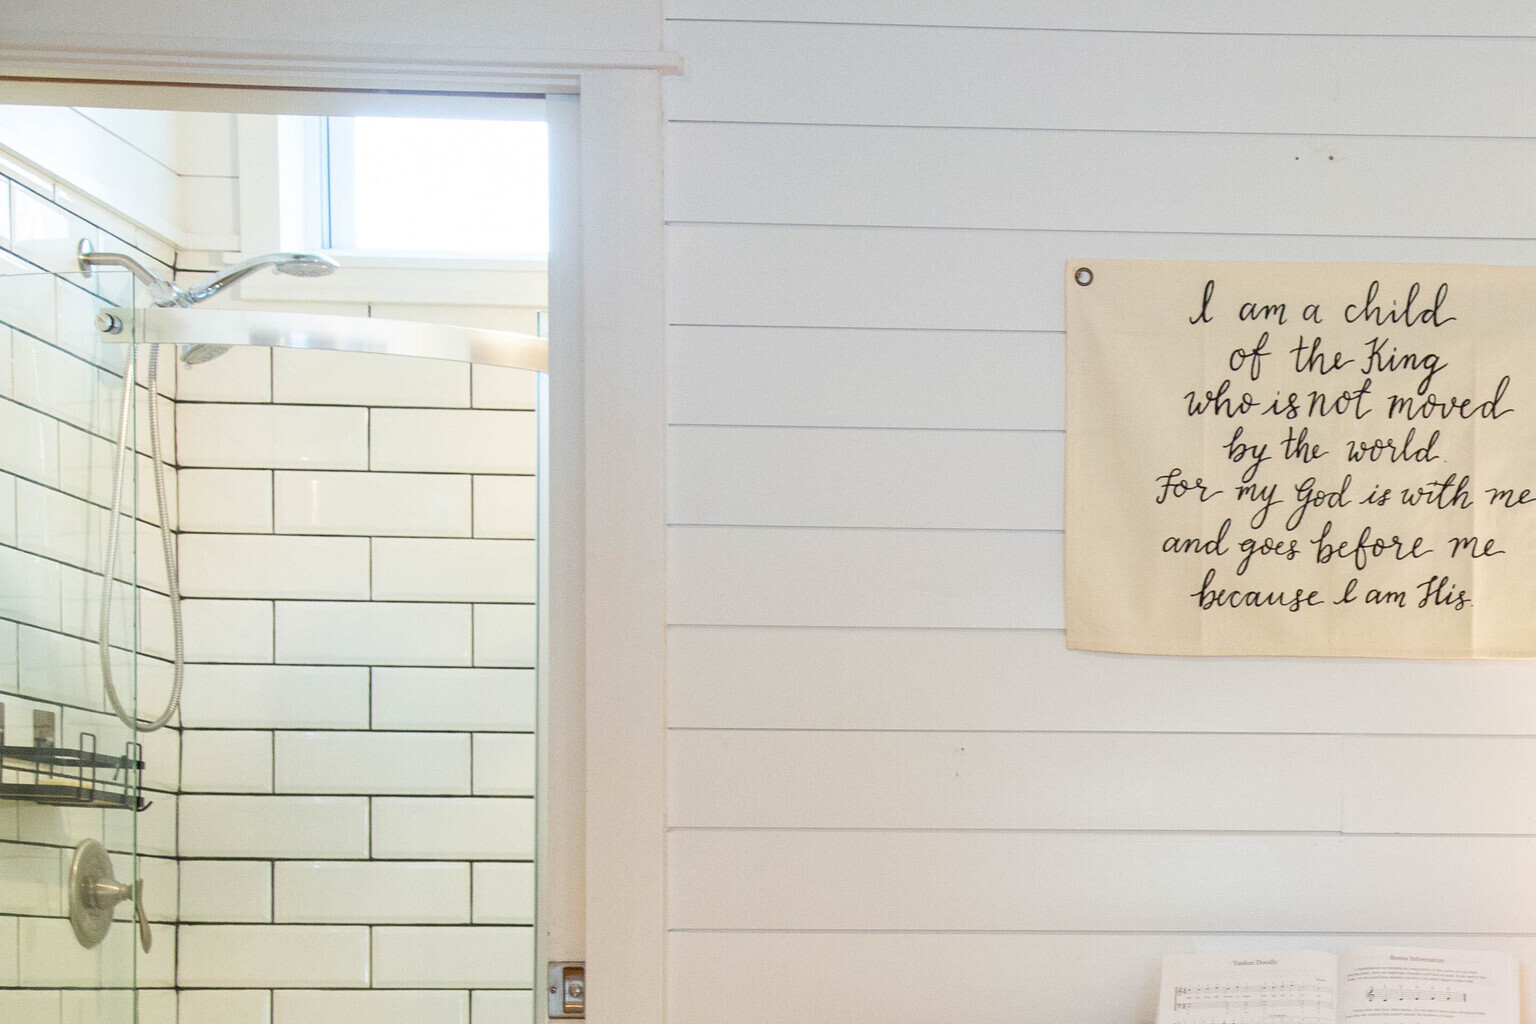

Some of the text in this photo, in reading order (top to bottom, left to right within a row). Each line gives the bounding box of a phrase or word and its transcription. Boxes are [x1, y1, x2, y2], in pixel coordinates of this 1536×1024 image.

[1189, 280, 1457, 327] I am a child
[1229, 331, 1448, 396] of the King
[1184, 375, 1515, 421] who is not moved
[1222, 426, 1272, 483] by
[1280, 426, 1329, 463] the
[1156, 468, 1223, 504] For
[1235, 483, 1284, 529] my
[1285, 474, 1352, 531] God
[1359, 484, 1391, 507] is
[1401, 473, 1474, 509] with
[1162, 518, 1506, 576] and goes before me
[1190, 568, 1324, 612] because
[1333, 578, 1358, 605] I
[1365, 589, 1406, 608] am
